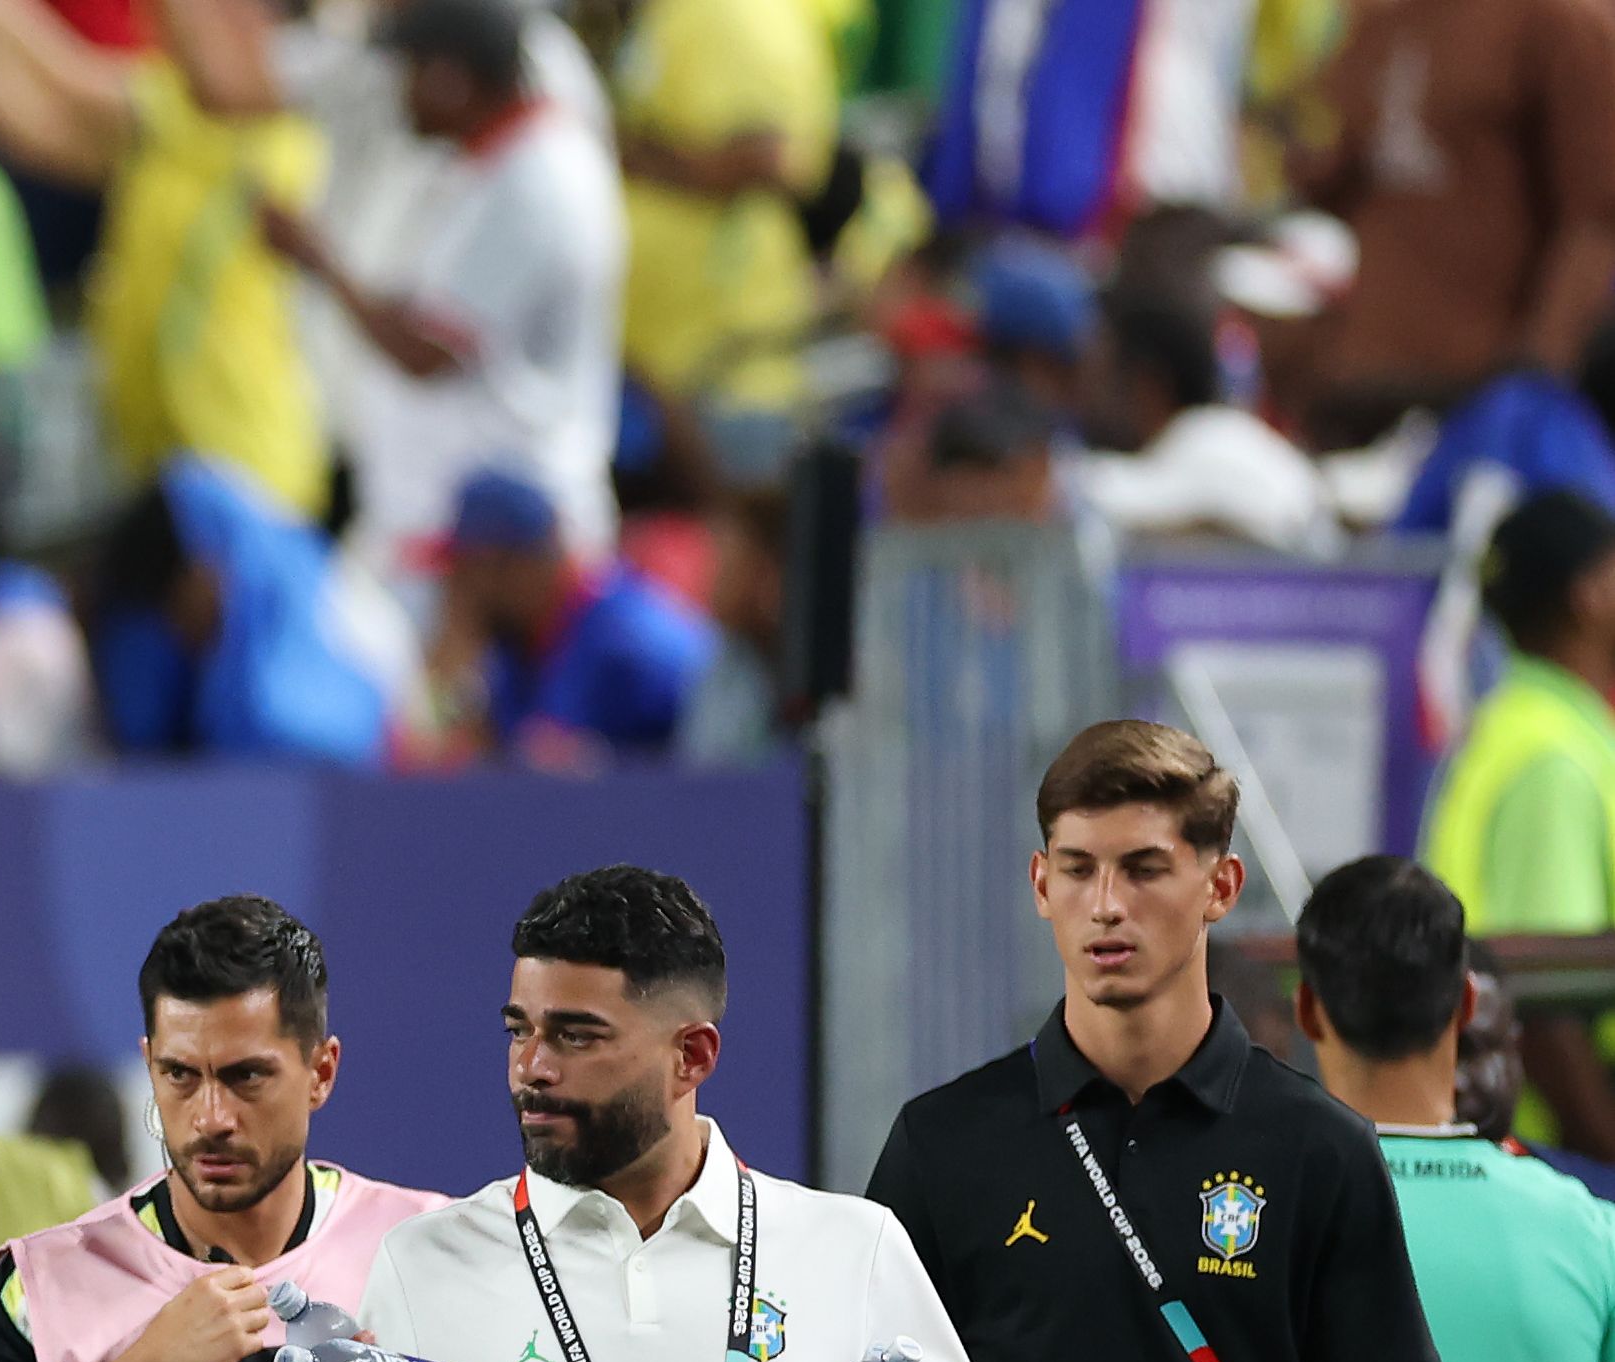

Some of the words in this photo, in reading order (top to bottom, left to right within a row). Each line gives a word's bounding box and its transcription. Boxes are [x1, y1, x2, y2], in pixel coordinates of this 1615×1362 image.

[1065, 1121, 1090, 1158] FIFA
[1082, 1153, 1117, 1208] WORLD
[1109, 1205, 1134, 1237] CUP
[1125, 1235, 1163, 1291] 2026
[522, 1219, 547, 1268] 2026
[740, 1207, 754, 1256] WORLD
[537, 1267, 557, 1294] CUP
[738, 1255, 752, 1285] CUP
[1197, 1256, 1257, 1279] BRASIL
[548, 1293, 576, 1344] WORLD
[733, 1284, 750, 1338] 2026
